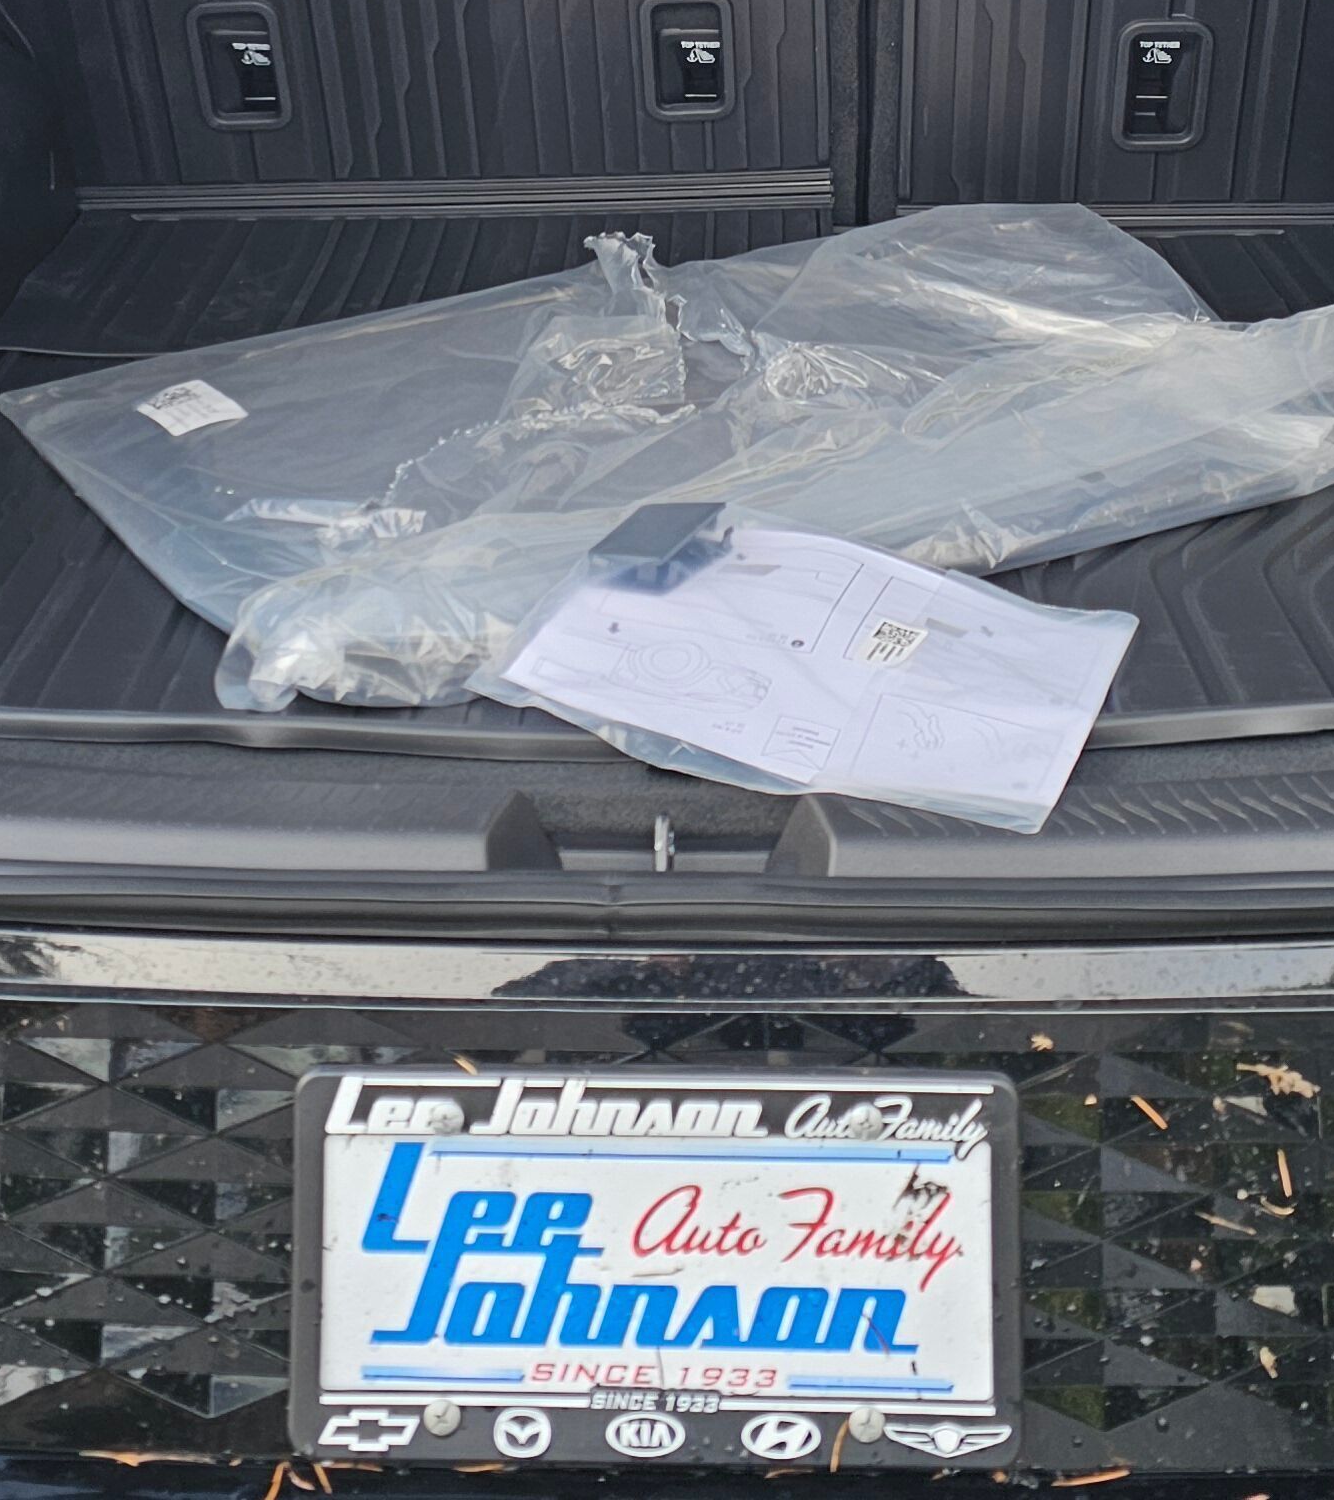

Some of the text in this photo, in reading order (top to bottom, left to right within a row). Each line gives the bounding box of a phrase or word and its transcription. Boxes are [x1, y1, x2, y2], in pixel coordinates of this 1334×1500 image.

[469, 1076, 768, 1137] Johnson
[784, 1094, 857, 1139] Aut
[870, 1094, 989, 1160] Family
[362, 1142, 604, 1256] Lee
[632, 1184, 962, 1291] Auto Family
[370, 1236, 919, 1353] Johnson
[531, 1362, 779, 1389] SINCE 1933
[590, 1390, 721, 1414] SINCE 1933
[619, 1420, 673, 1449] KIA
